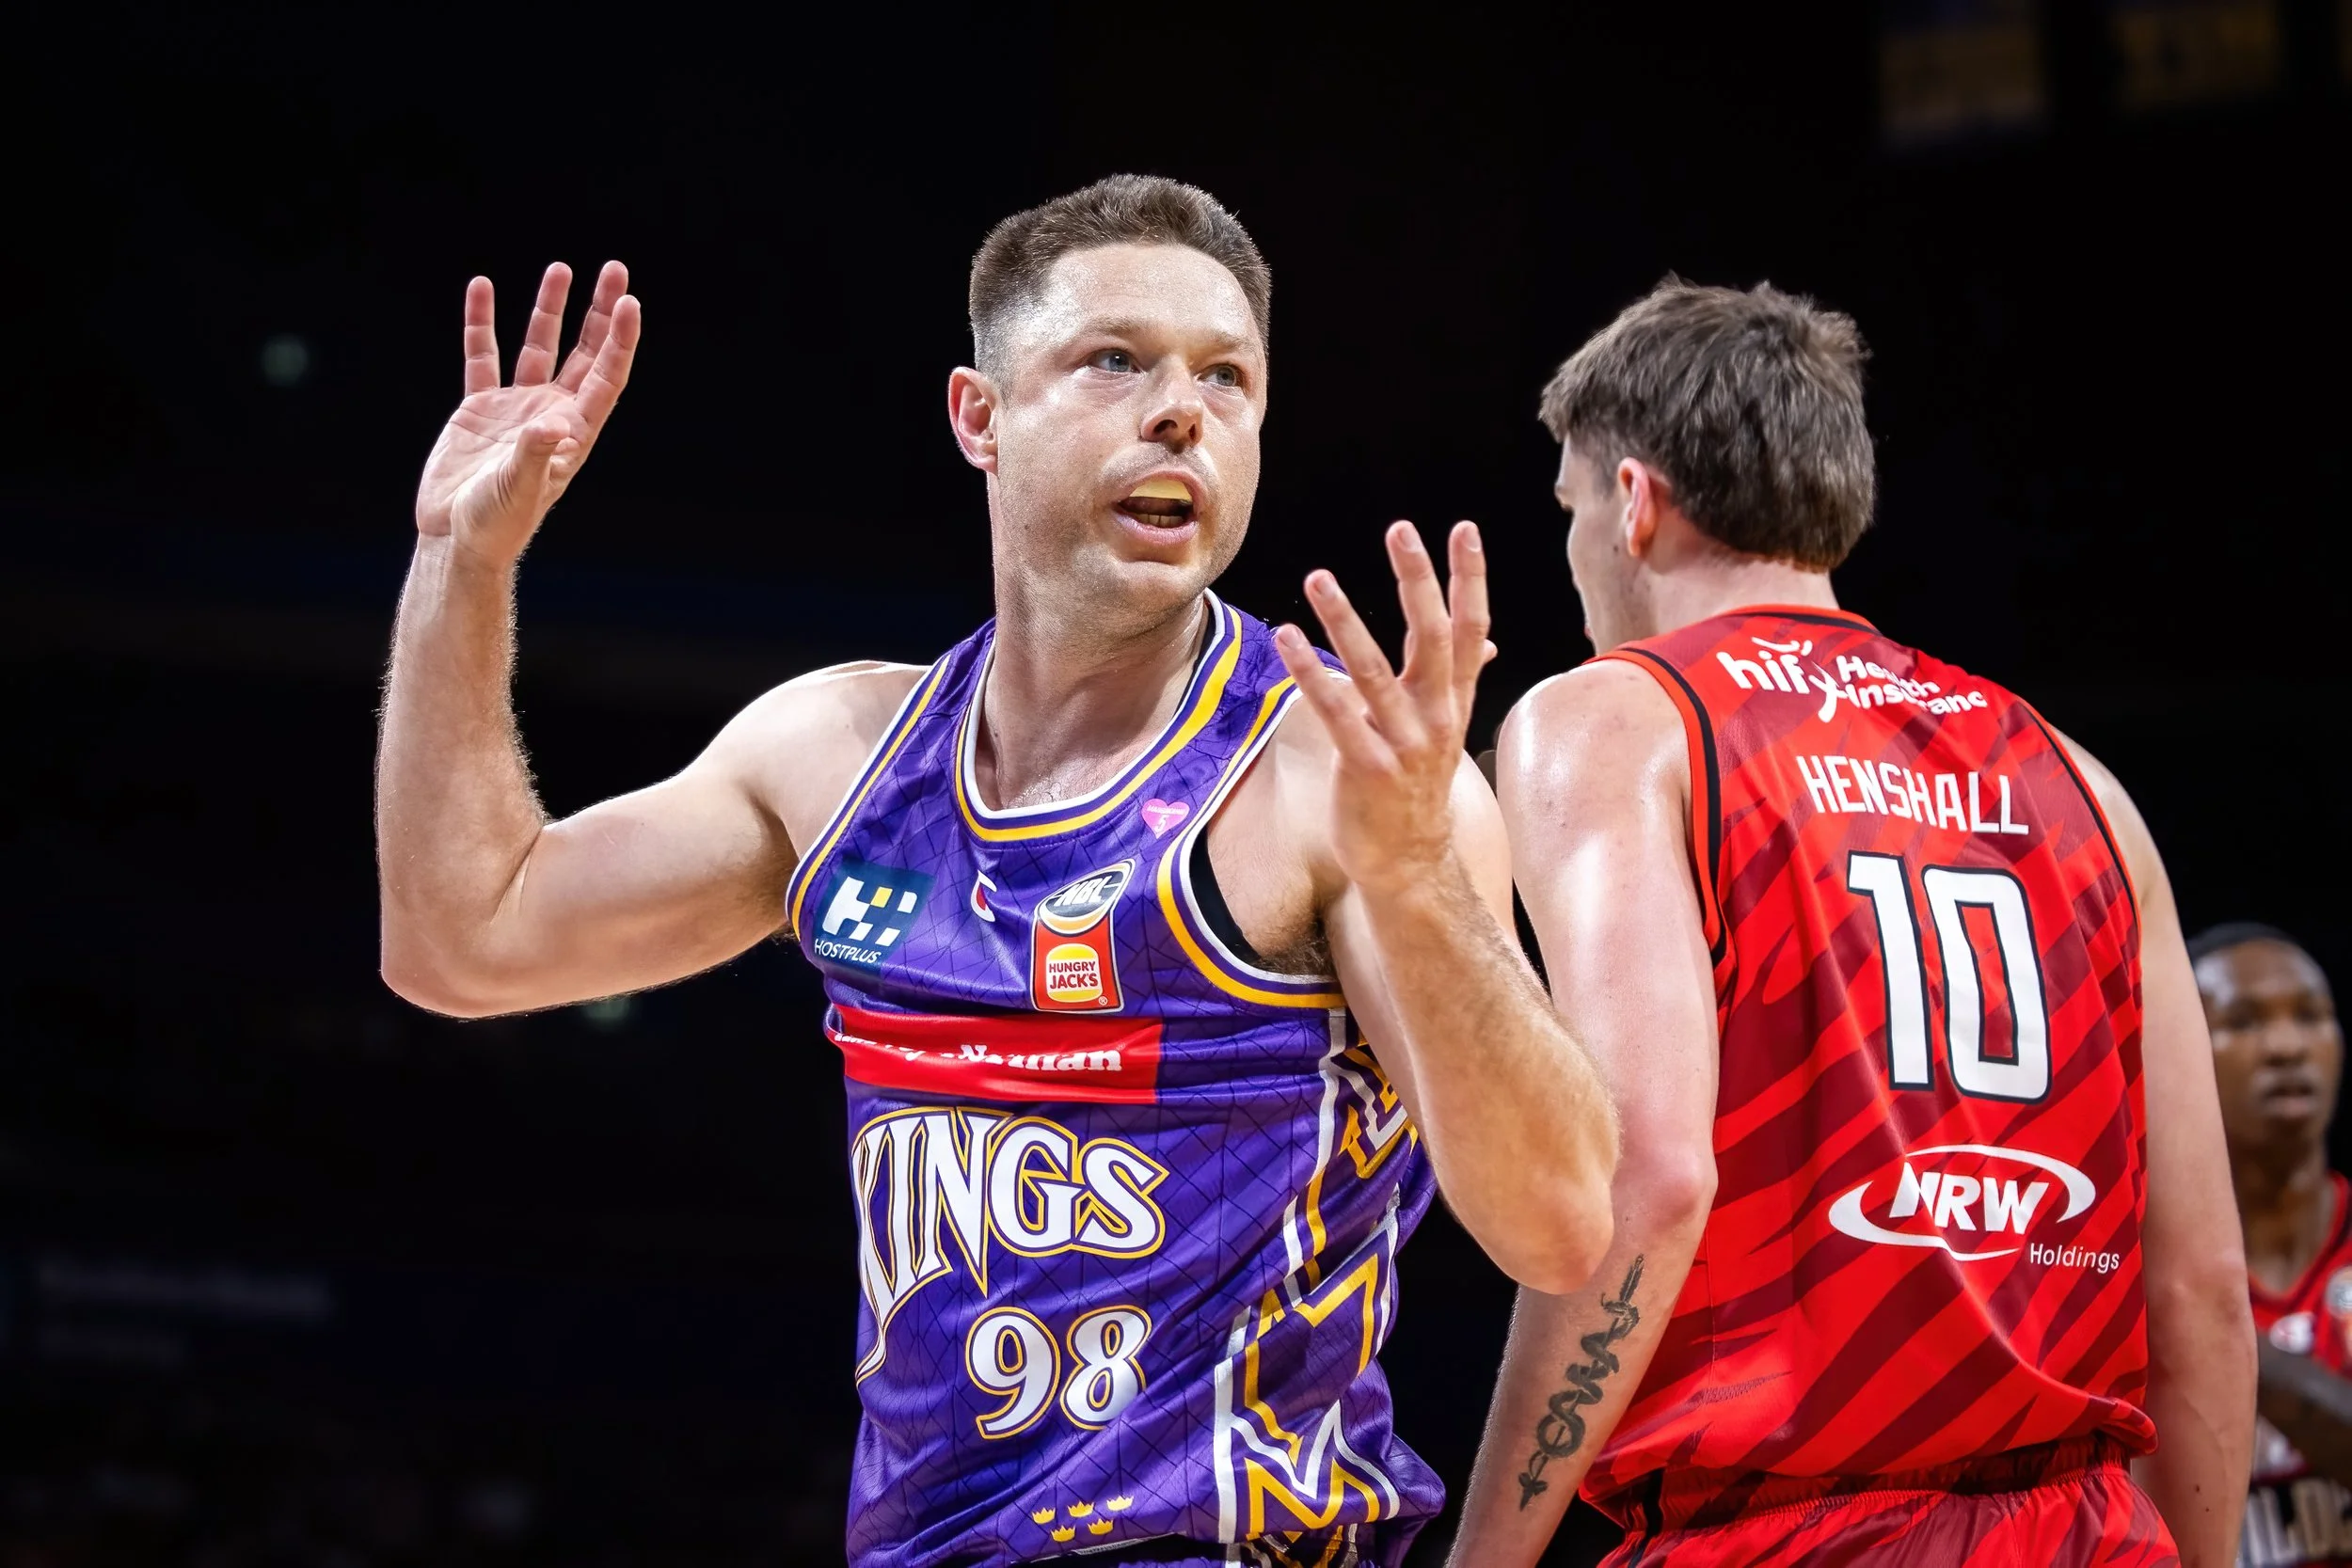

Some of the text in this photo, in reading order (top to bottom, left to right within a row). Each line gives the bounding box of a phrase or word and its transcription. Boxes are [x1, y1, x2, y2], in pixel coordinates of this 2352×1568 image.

[1796, 755, 2029, 835] HENSHALL
[1053, 874, 1113, 907] NBL
[814, 938, 882, 964] HOSTPLUS
[1049, 961, 1096, 974] HUNGRY
[1049, 973, 1099, 990] JACK'S
[1847, 850, 2053, 1103] 10
[1888, 1162, 2049, 1234] NRW
[2030, 1243, 2120, 1274] Holdings
[965, 1305, 1153, 1440] 98
